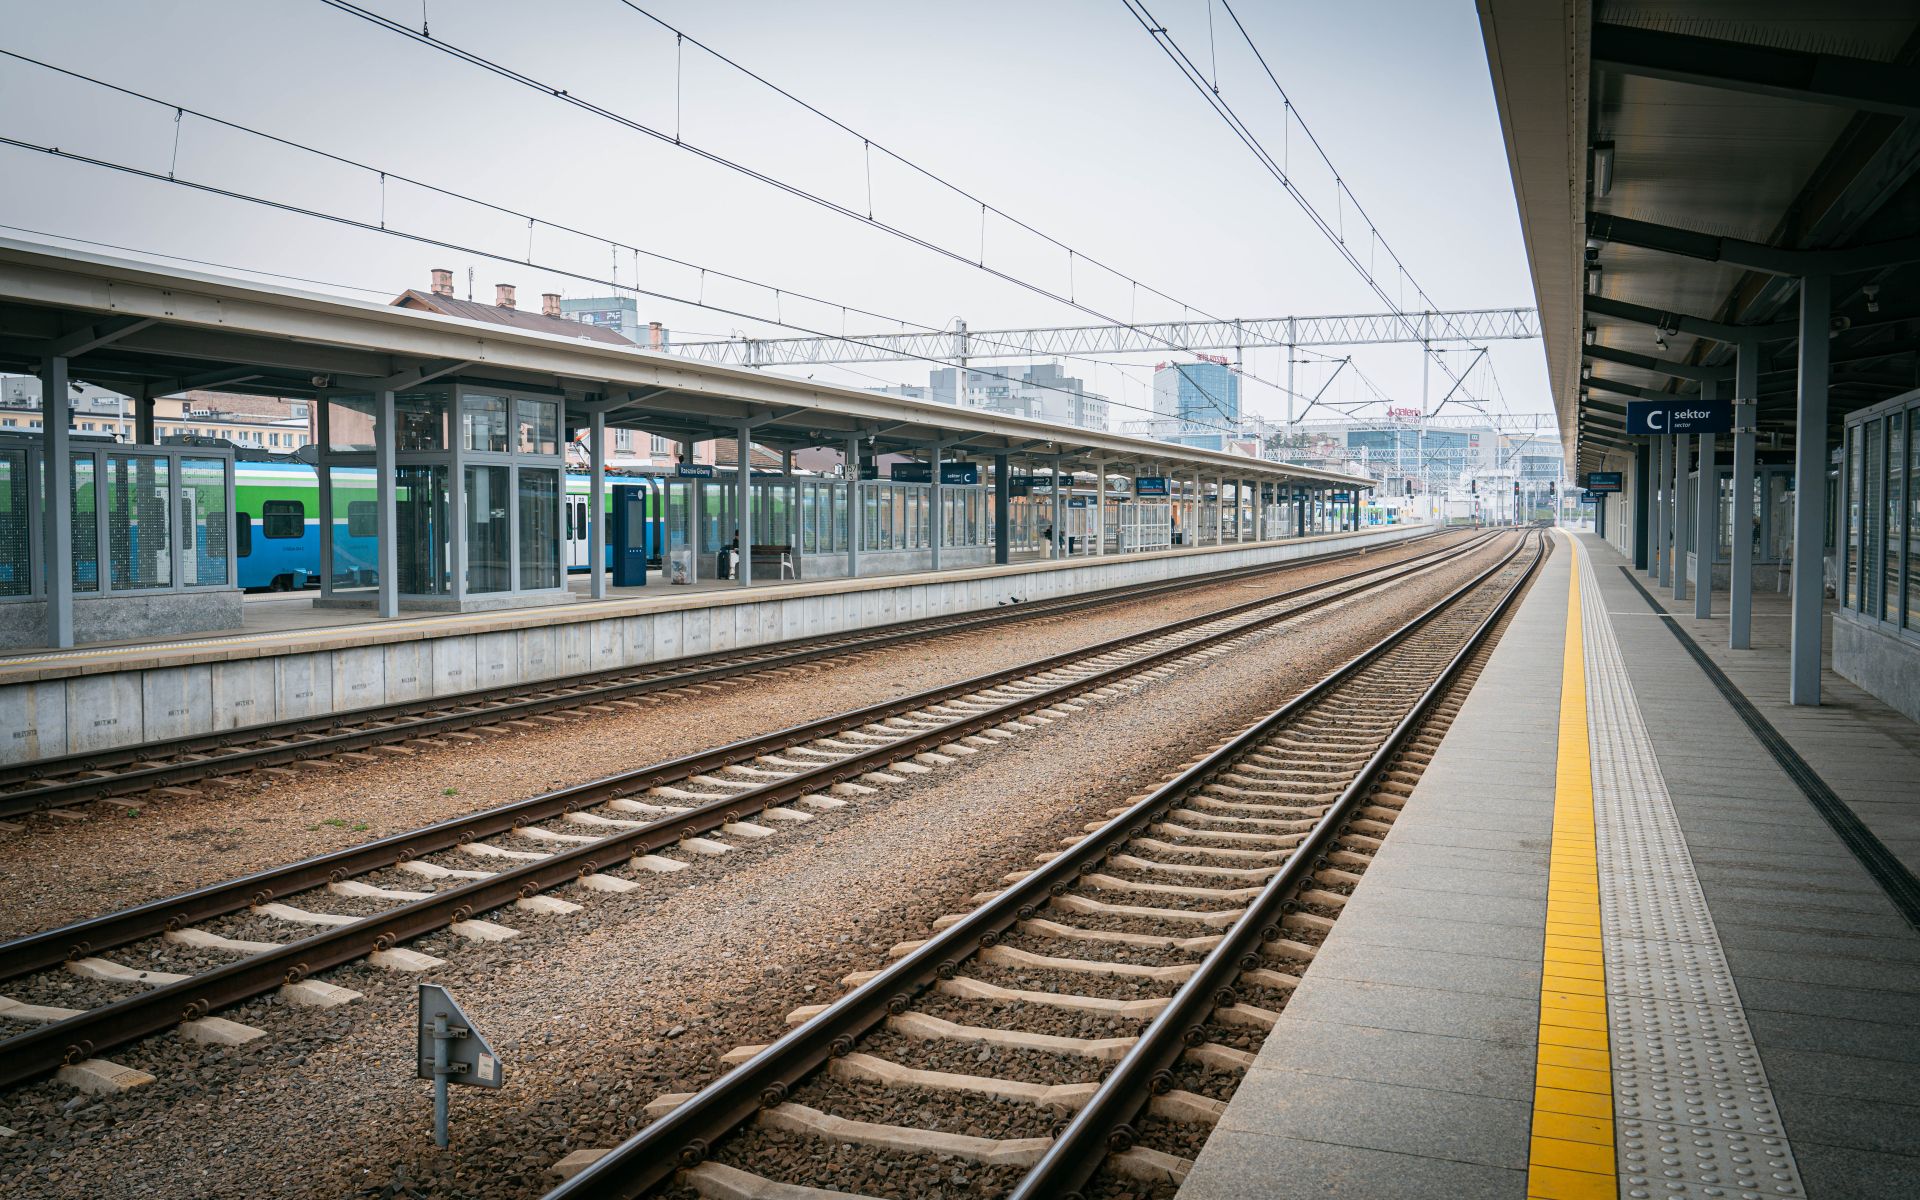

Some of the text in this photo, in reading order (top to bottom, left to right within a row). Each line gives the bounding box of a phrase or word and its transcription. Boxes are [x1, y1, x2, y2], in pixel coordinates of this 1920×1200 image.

[1394, 407, 1421, 417] galeria
[1646, 408, 1711, 430] C sektor
[846, 465, 857, 473] 157
[964, 473, 971, 482] C
